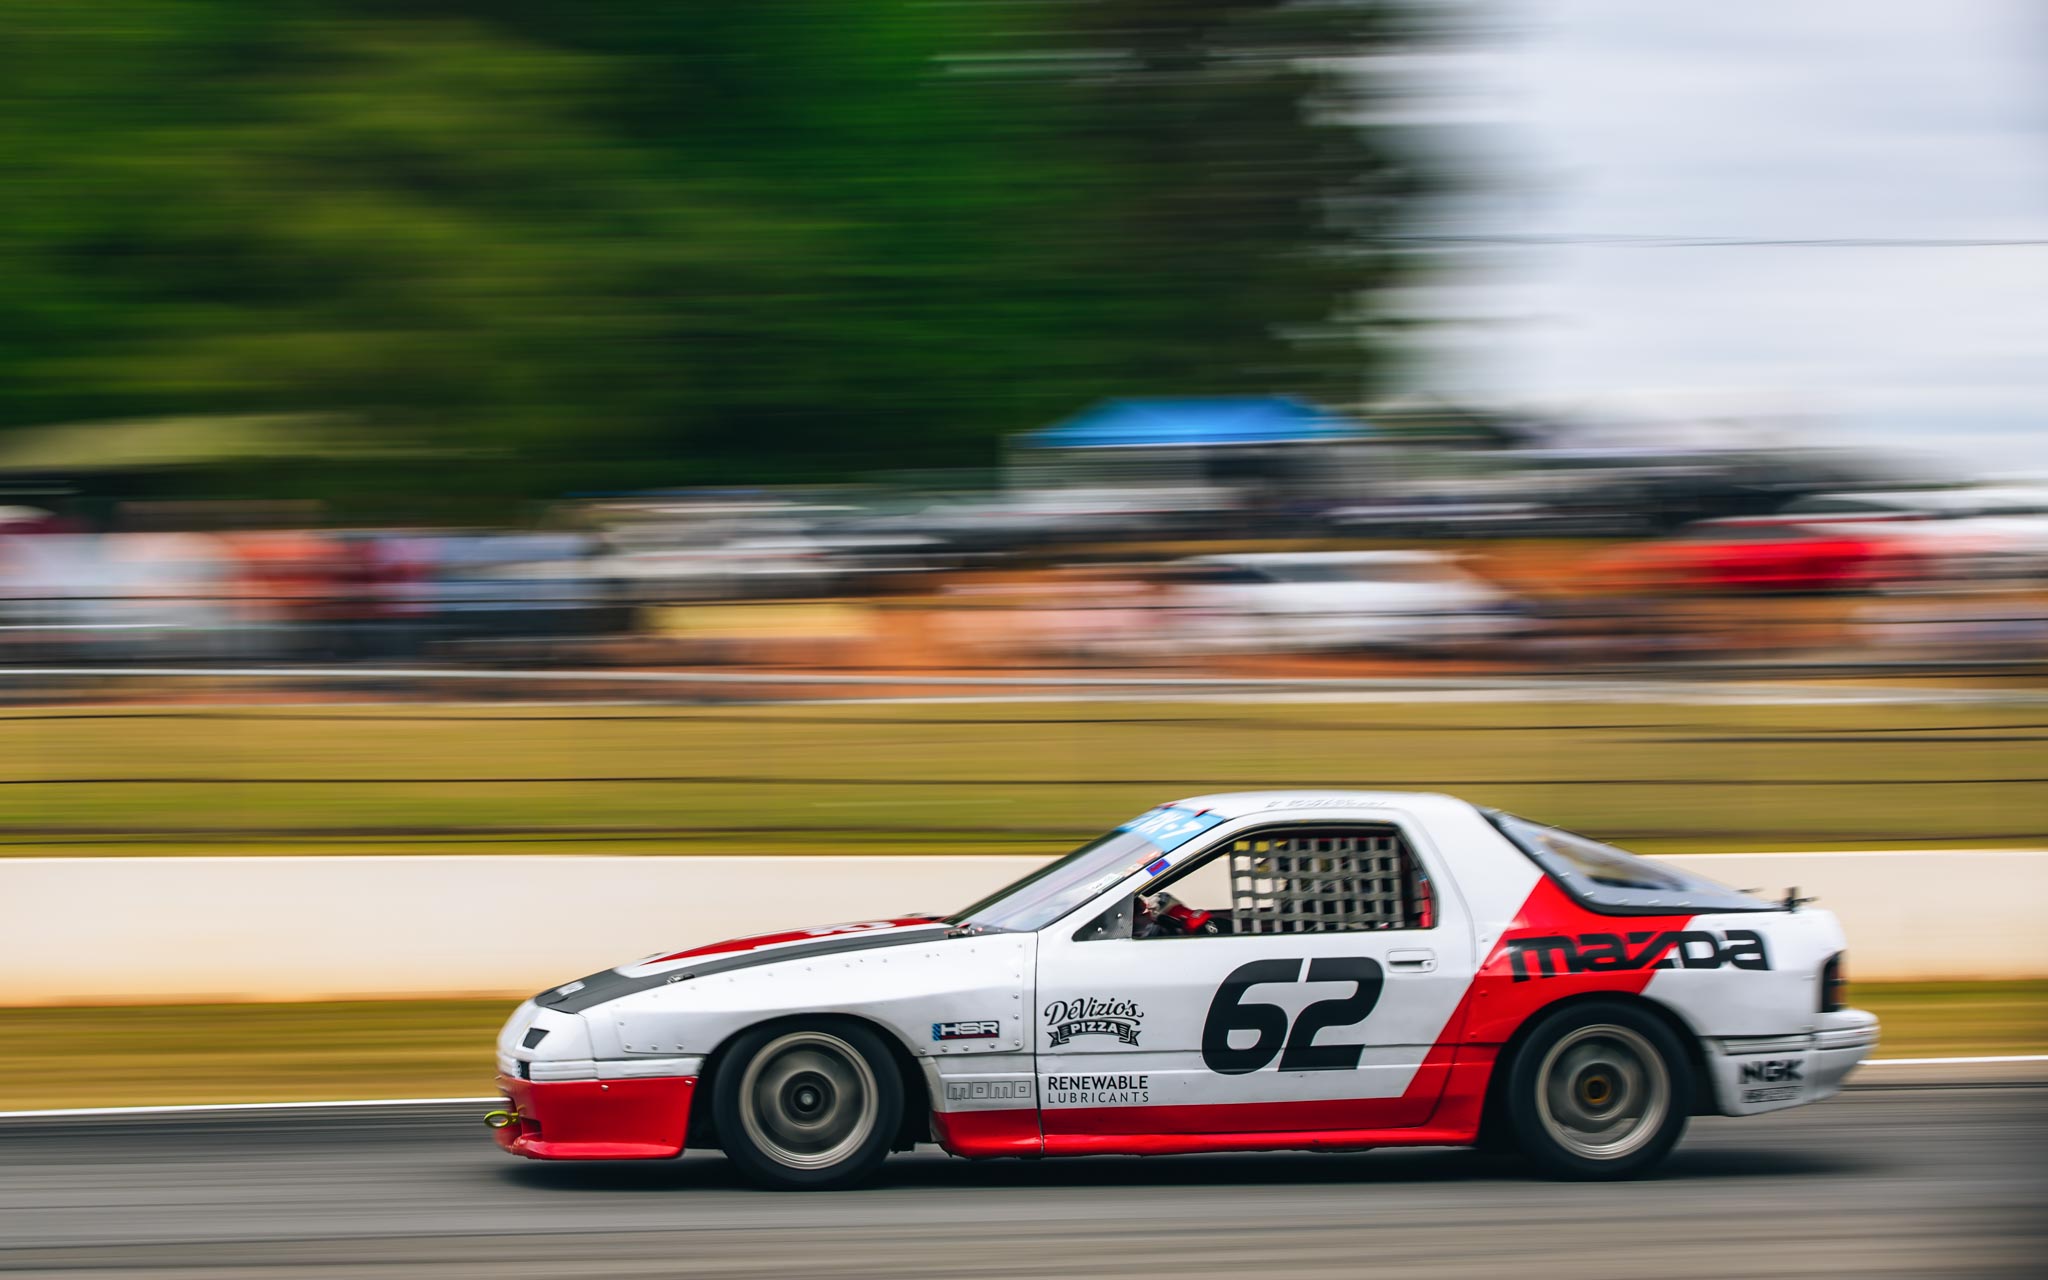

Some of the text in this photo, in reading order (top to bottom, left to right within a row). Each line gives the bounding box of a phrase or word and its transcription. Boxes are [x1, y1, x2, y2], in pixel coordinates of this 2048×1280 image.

[1044, 997, 1144, 1026] DeVizio's
[1202, 956, 1384, 1075] 62
[941, 1021, 998, 1036] HSR
[1070, 1021, 1118, 1034] PIZZA
[1738, 1059, 1804, 1084] NGK
[1048, 1076, 1149, 1090] RENEWABLE
[1048, 1092, 1149, 1103] LUBRICANTS
